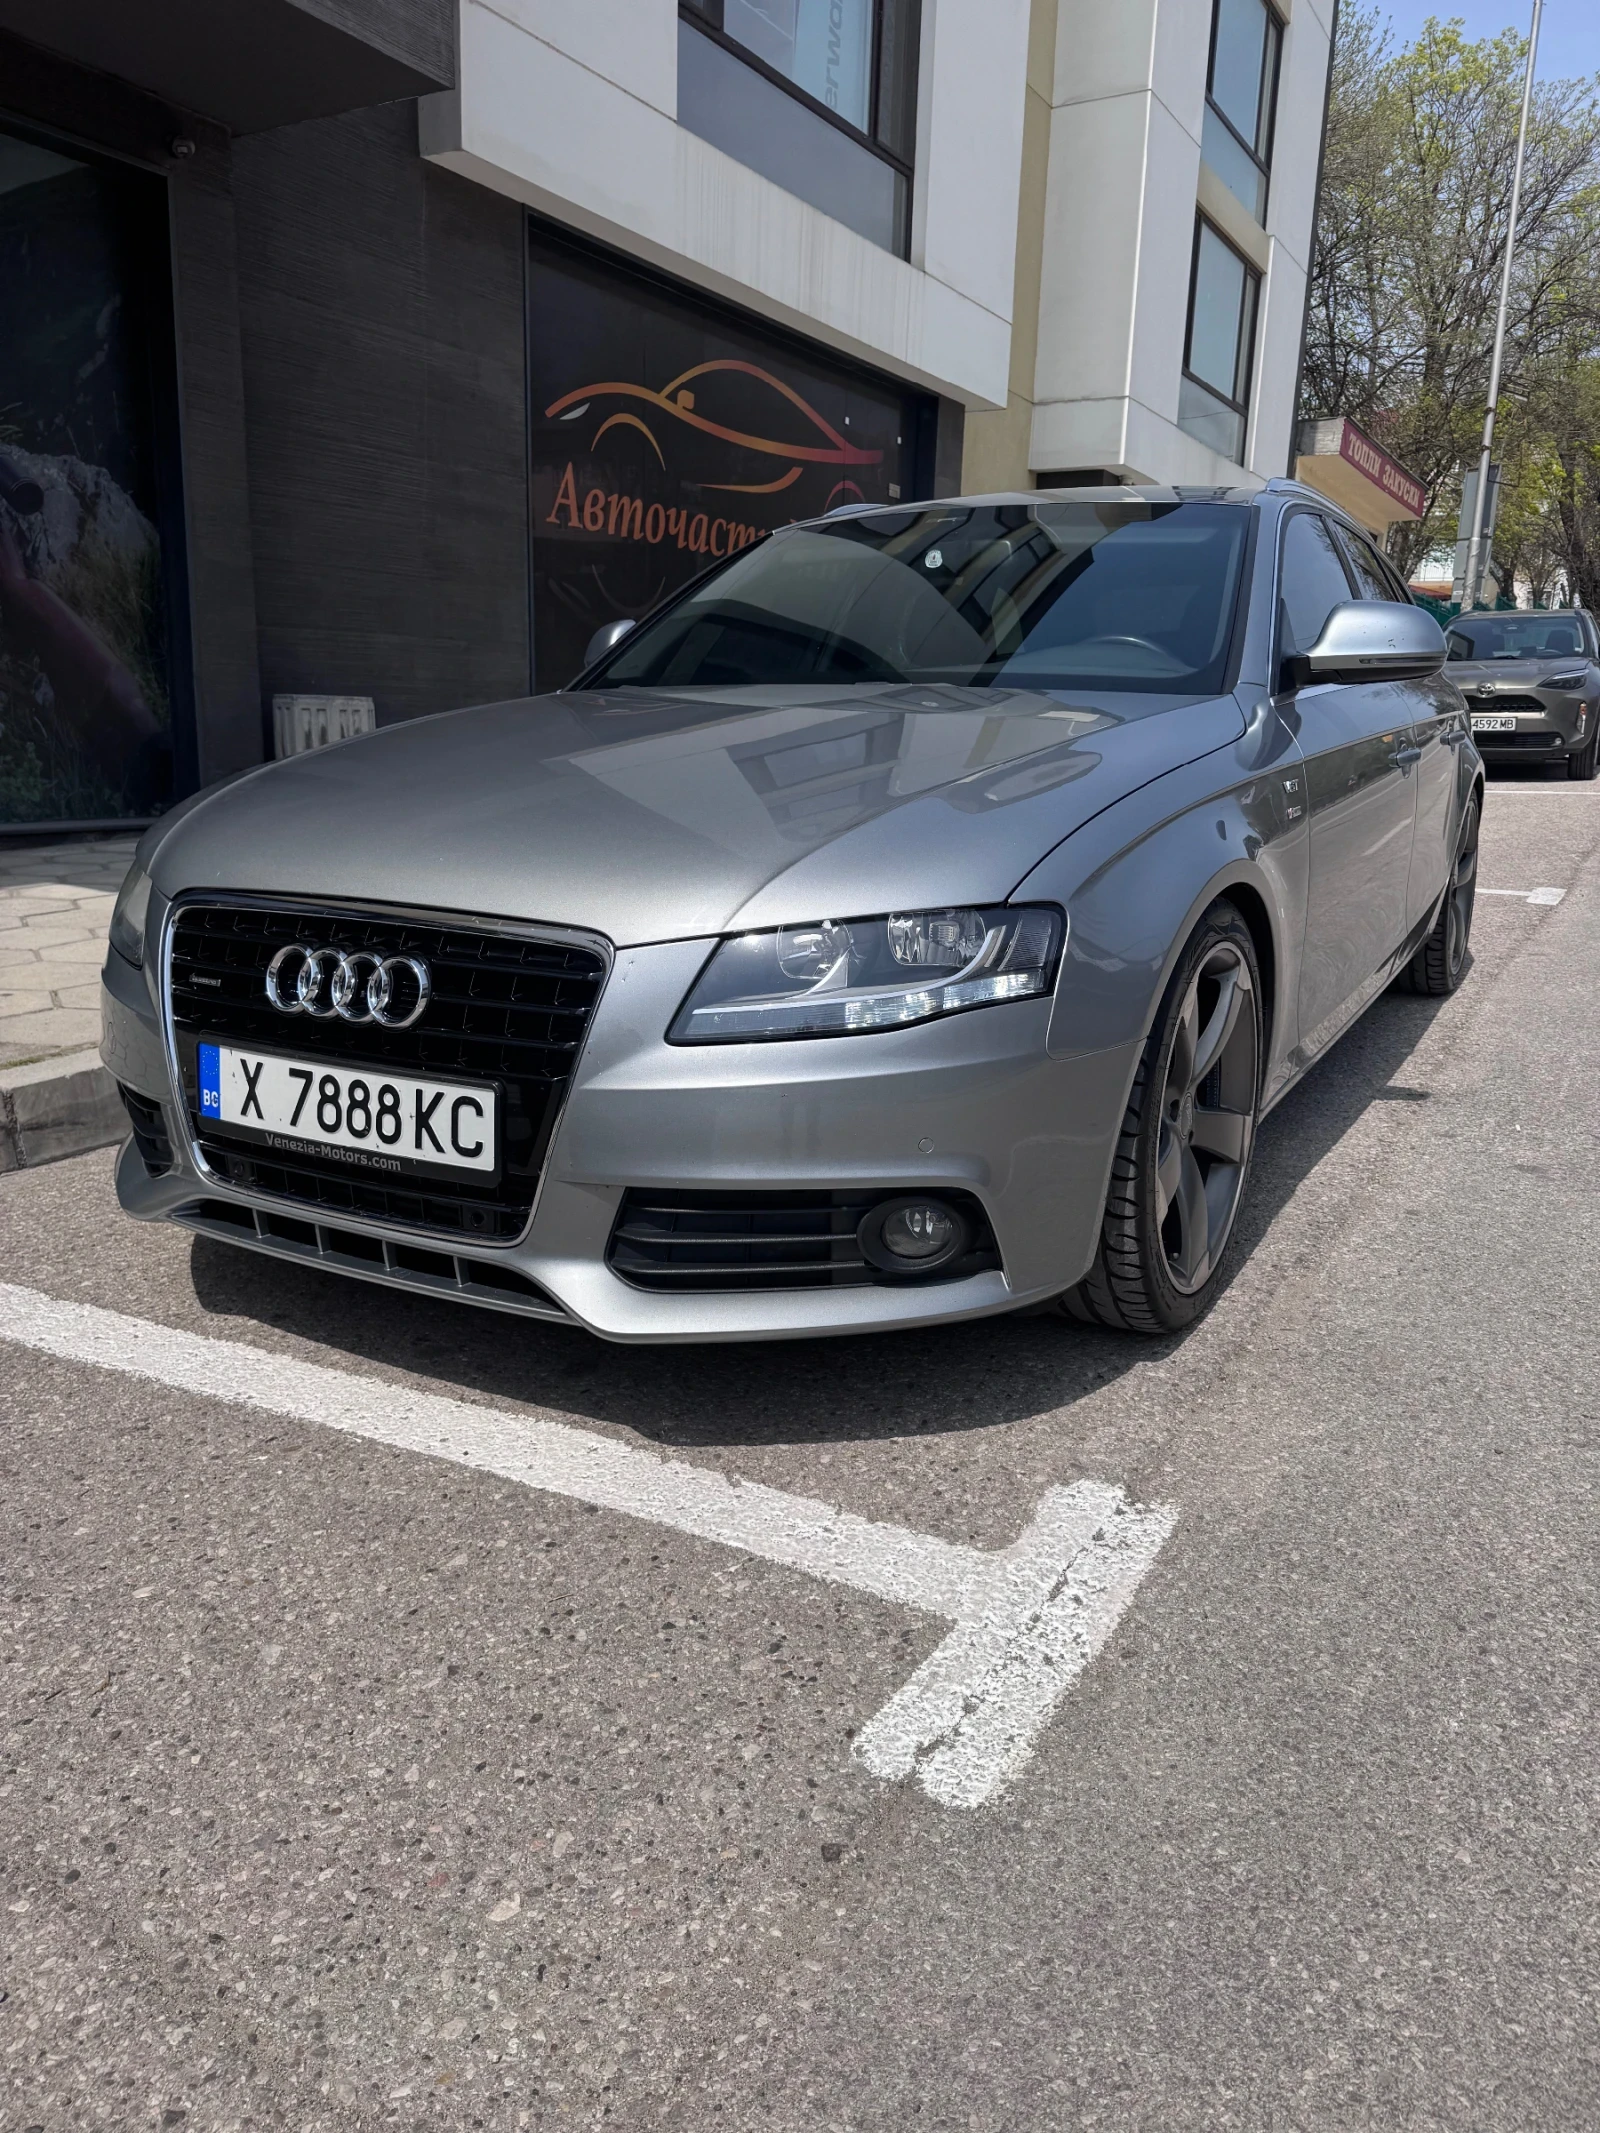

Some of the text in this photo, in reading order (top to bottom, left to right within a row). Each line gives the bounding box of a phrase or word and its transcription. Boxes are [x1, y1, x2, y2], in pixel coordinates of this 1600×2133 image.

[824, 0, 844, 111] erwa
[1348, 433, 1420, 508] ТОПЛИ ЗАКУСКИ
[546, 461, 766, 557] Авточаст
[1472, 719, 1498, 729] 4592
[203, 1088, 219, 1108] BG
[240, 1058, 485, 1158] X 7888 KC
[265, 1132, 401, 1172] Venezia-Motors.com
